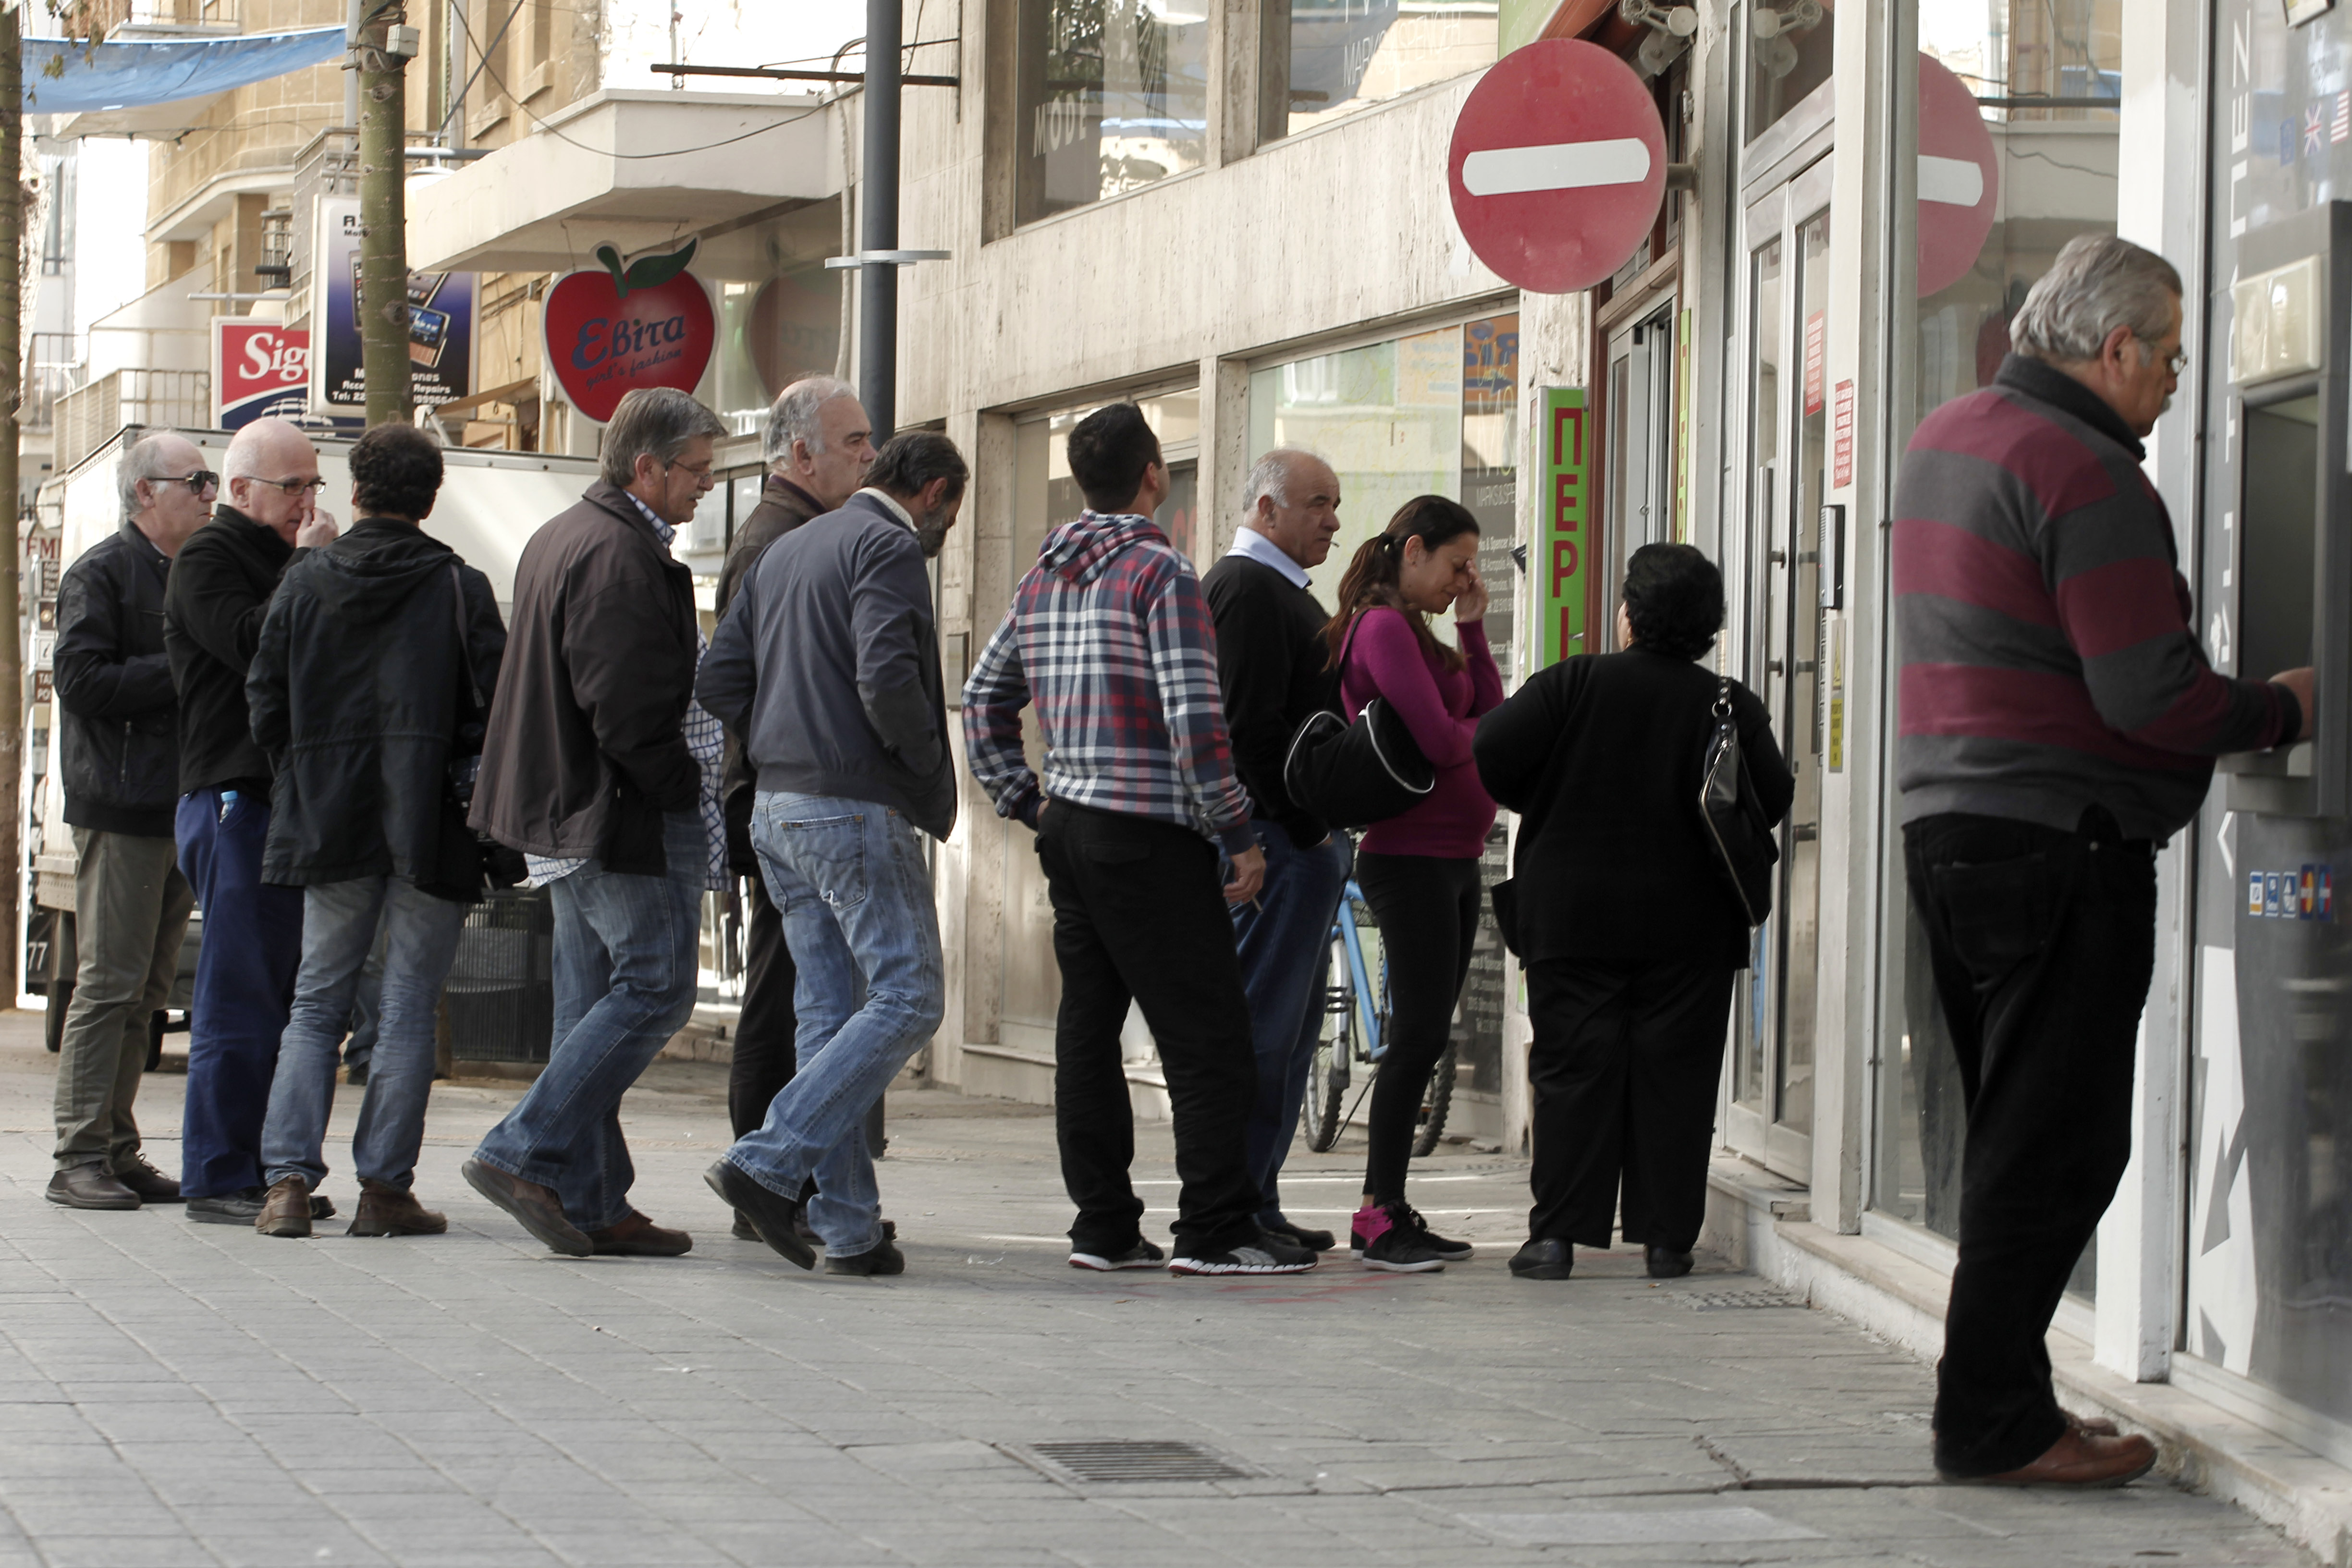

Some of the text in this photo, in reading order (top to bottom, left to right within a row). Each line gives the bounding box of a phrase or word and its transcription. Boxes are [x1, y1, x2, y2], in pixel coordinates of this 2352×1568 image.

[1033, 86, 1087, 158] MODE
[412, 373, 440, 382] ones
[413, 383, 451, 394] Repairs
